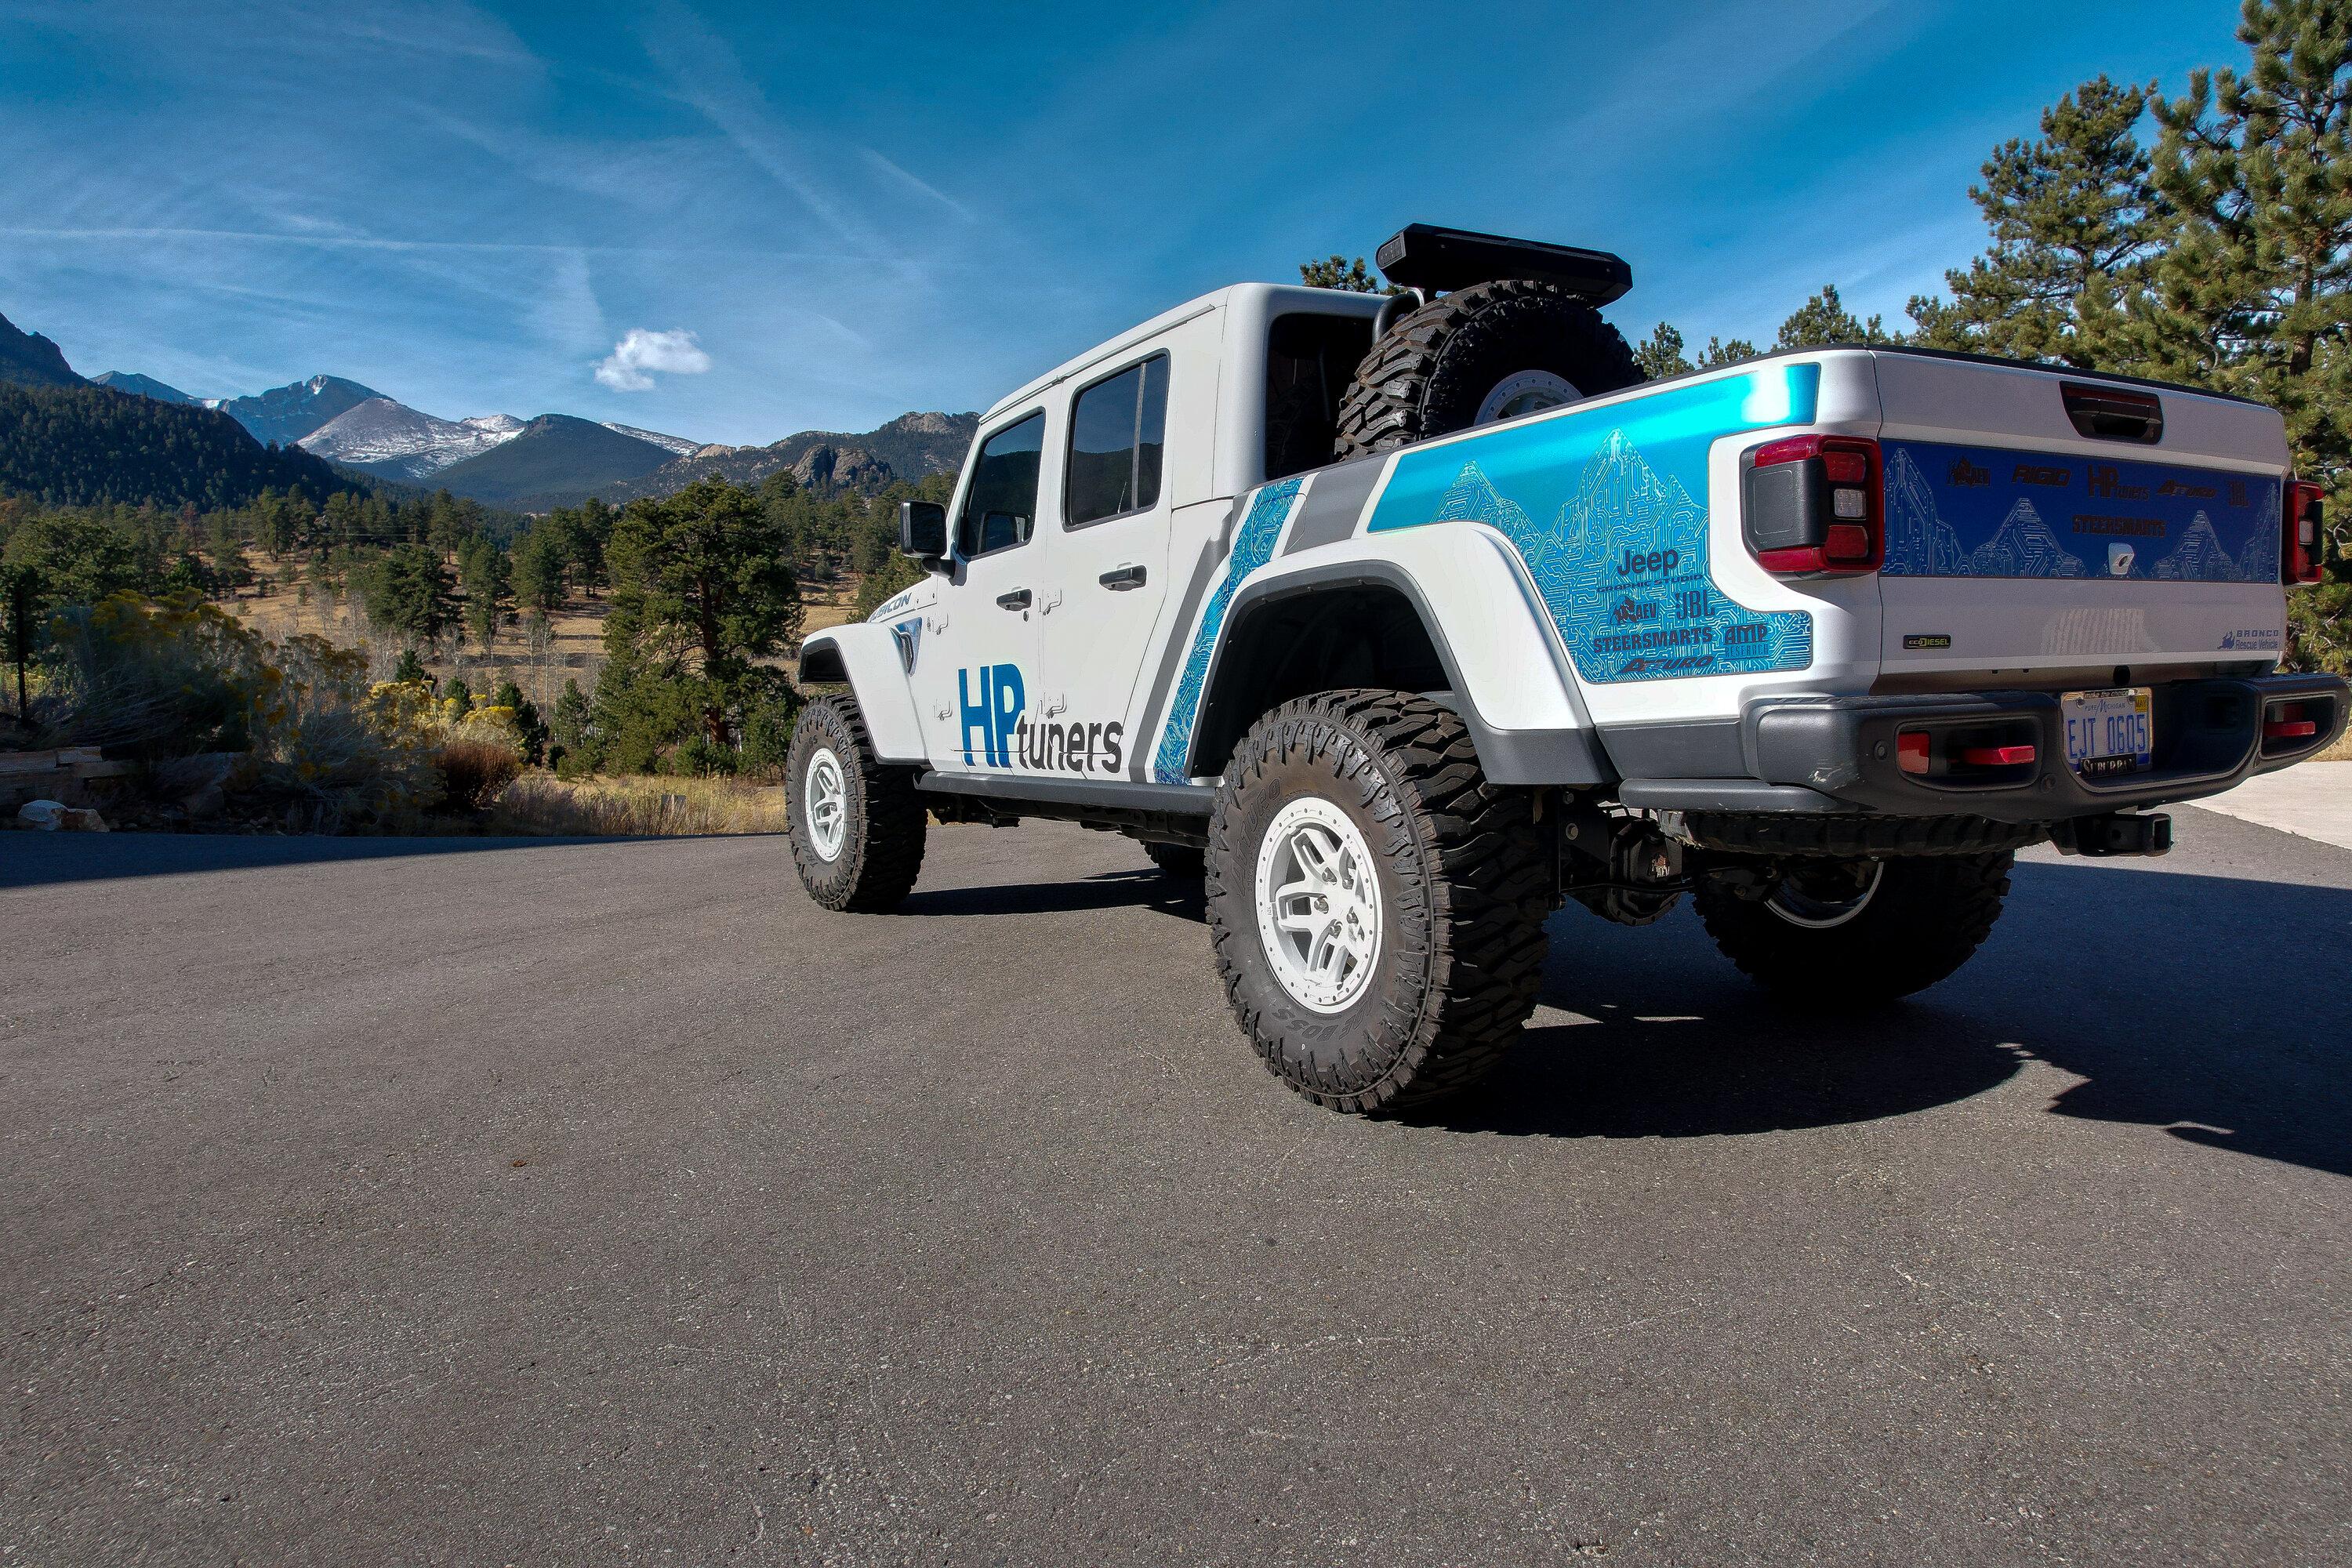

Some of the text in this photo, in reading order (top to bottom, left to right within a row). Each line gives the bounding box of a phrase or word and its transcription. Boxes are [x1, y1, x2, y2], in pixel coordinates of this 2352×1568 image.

[2071, 514, 2166, 538] STEERSMARTS
[1617, 548, 1679, 576] Jeep
[1653, 574, 1704, 586] STUDIO
[1635, 601, 1658, 620] AEV
[1675, 589, 1715, 620] JBL
[1593, 627, 1713, 654] STEERSMARTS
[1725, 643, 1769, 659] RESEARCH
[2236, 638, 2278, 650] Rescue Vehicle
[2067, 714, 2146, 759] EJT 0605
[1272, 1008, 1339, 1043] BOSS
